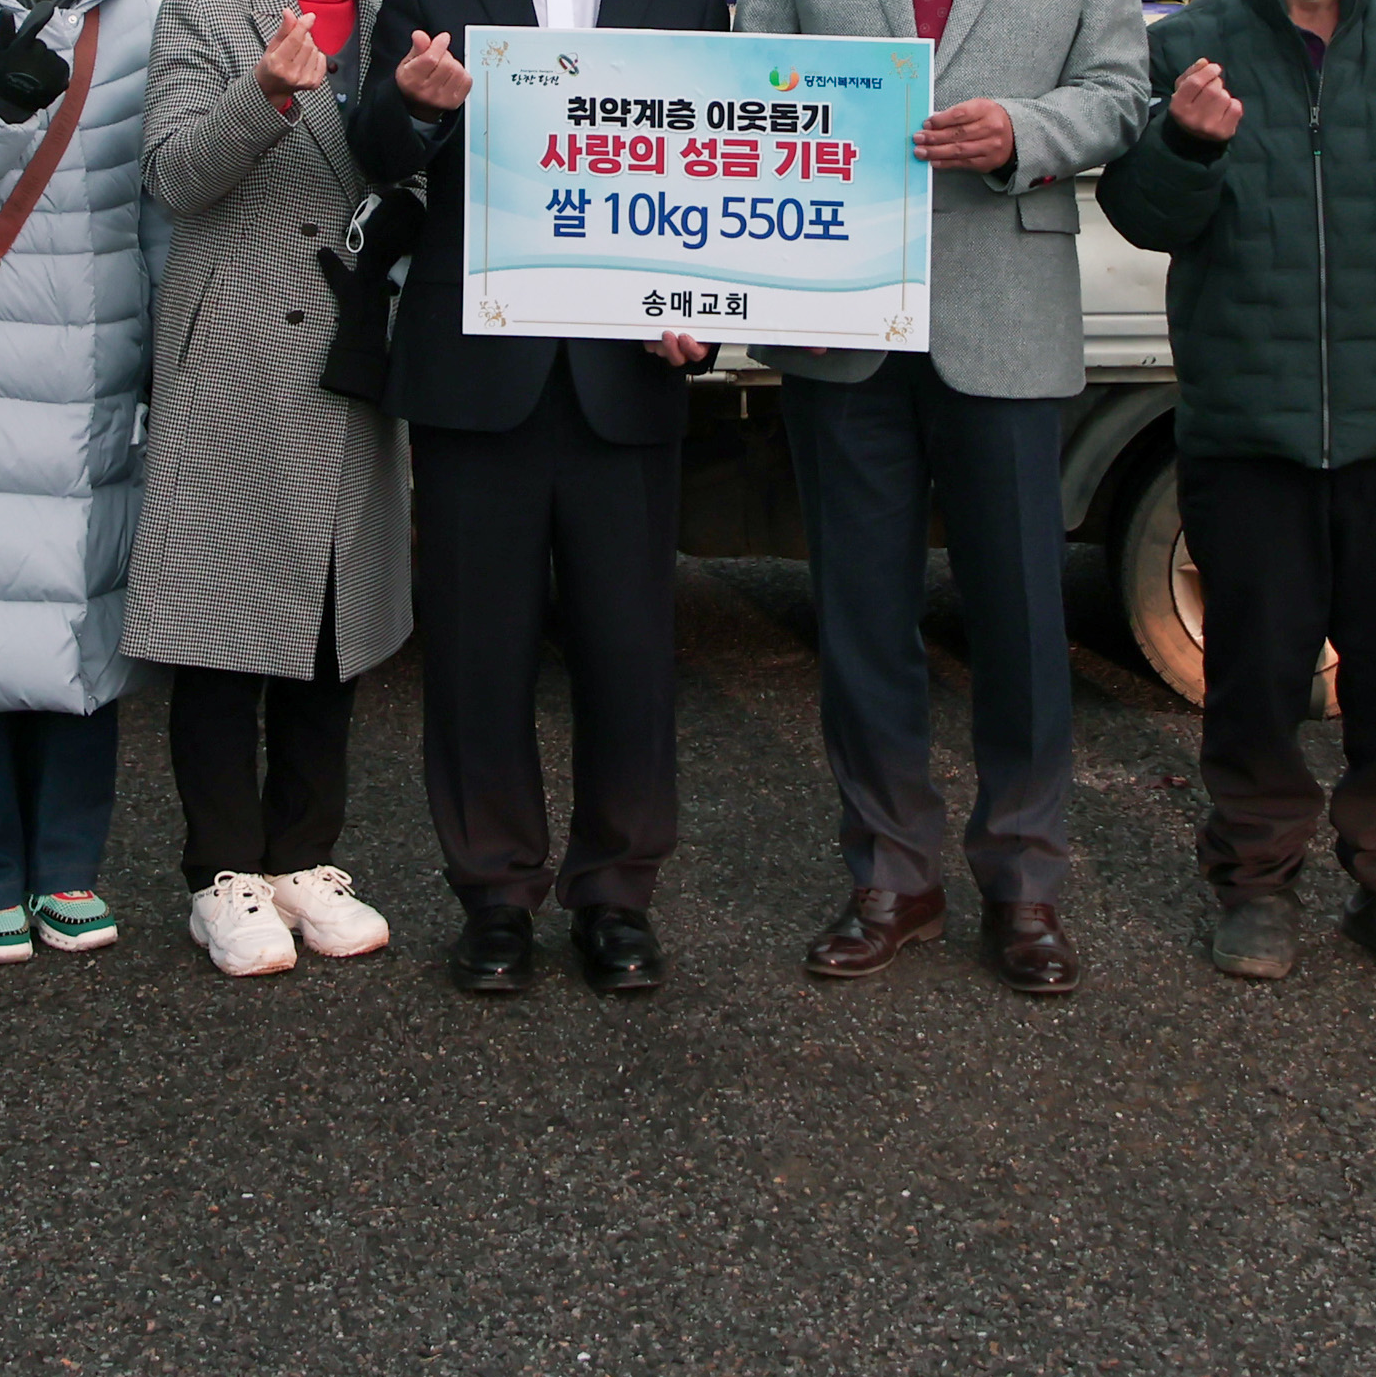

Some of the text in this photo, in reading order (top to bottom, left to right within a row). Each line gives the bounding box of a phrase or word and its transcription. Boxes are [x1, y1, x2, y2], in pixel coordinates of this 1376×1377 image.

[804, 75, 884, 90] 당진시복지재단
[566, 96, 831, 135] 취약계층 이웃돕기
[540, 133, 859, 182] 사랑의 성금 기탁
[545, 187, 850, 250] 쌀 10kg 550포
[641, 290, 749, 320] 송매교회
